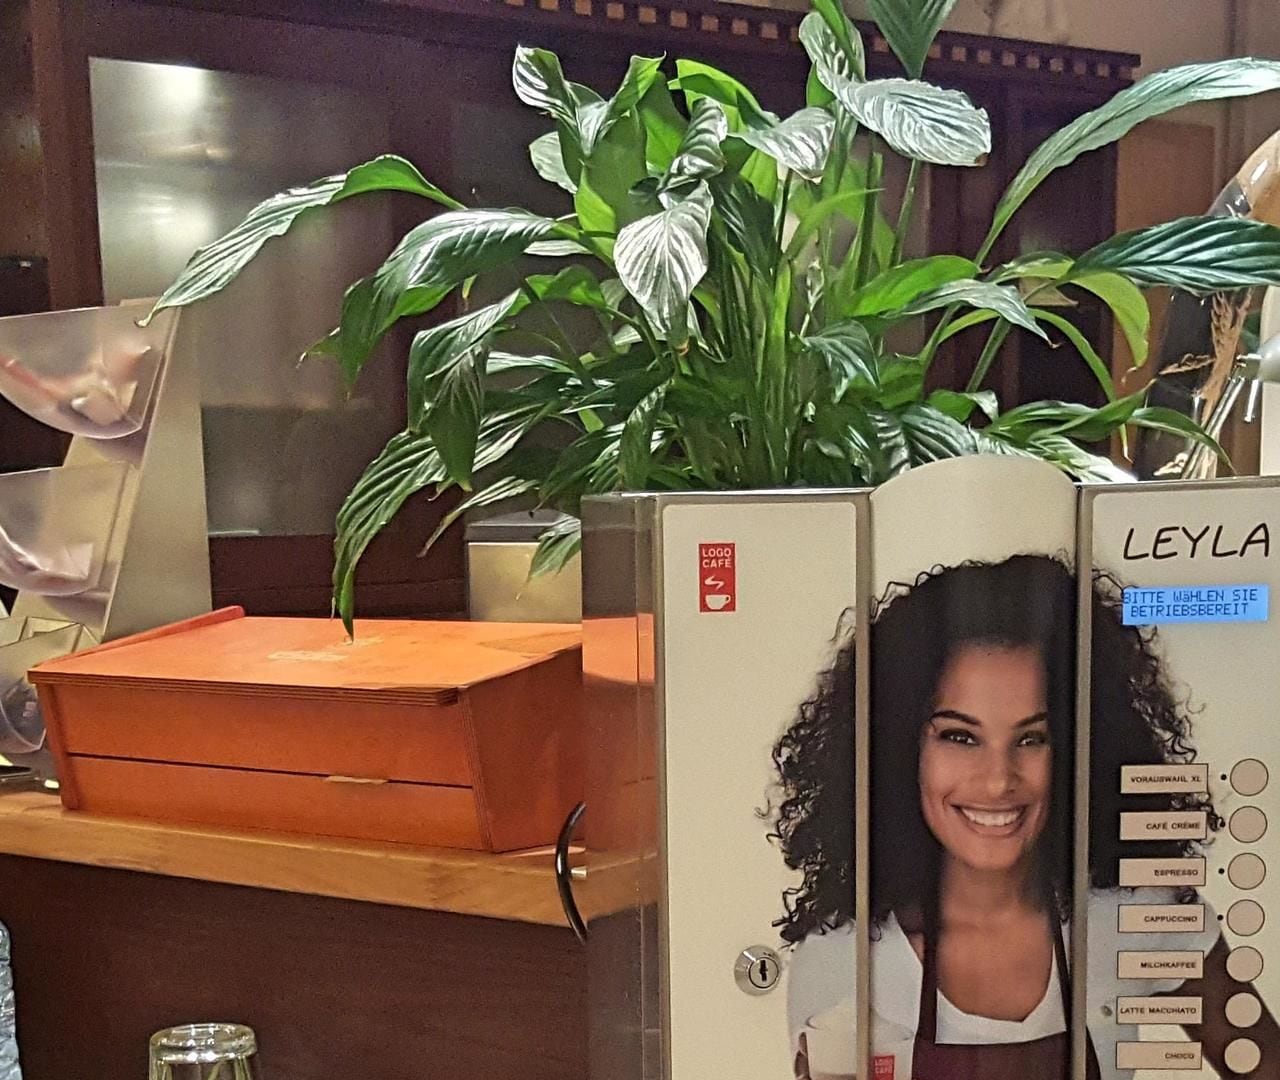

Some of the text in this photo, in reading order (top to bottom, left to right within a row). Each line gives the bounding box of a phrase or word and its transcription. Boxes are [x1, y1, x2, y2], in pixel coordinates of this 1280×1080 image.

[1123, 523, 1270, 560] LEYLA
[702, 547, 732, 558] LOGO
[1122, 590, 1165, 604] BITTE
[1232, 588, 1258, 601] SIE
[1130, 602, 1248, 617] BETRIEBSBEREIT
[1130, 775, 1201, 784] VORAUSWAHL XL
[1154, 868, 1199, 877] ESPRESSO
[1144, 914, 1198, 923] CAPPUCCINO
[1140, 961, 1196, 969] MILCHKAFFEE
[1120, 1006, 1197, 1015] LATTE MACCHIATO
[1165, 1052, 1195, 1060] CHOCO
